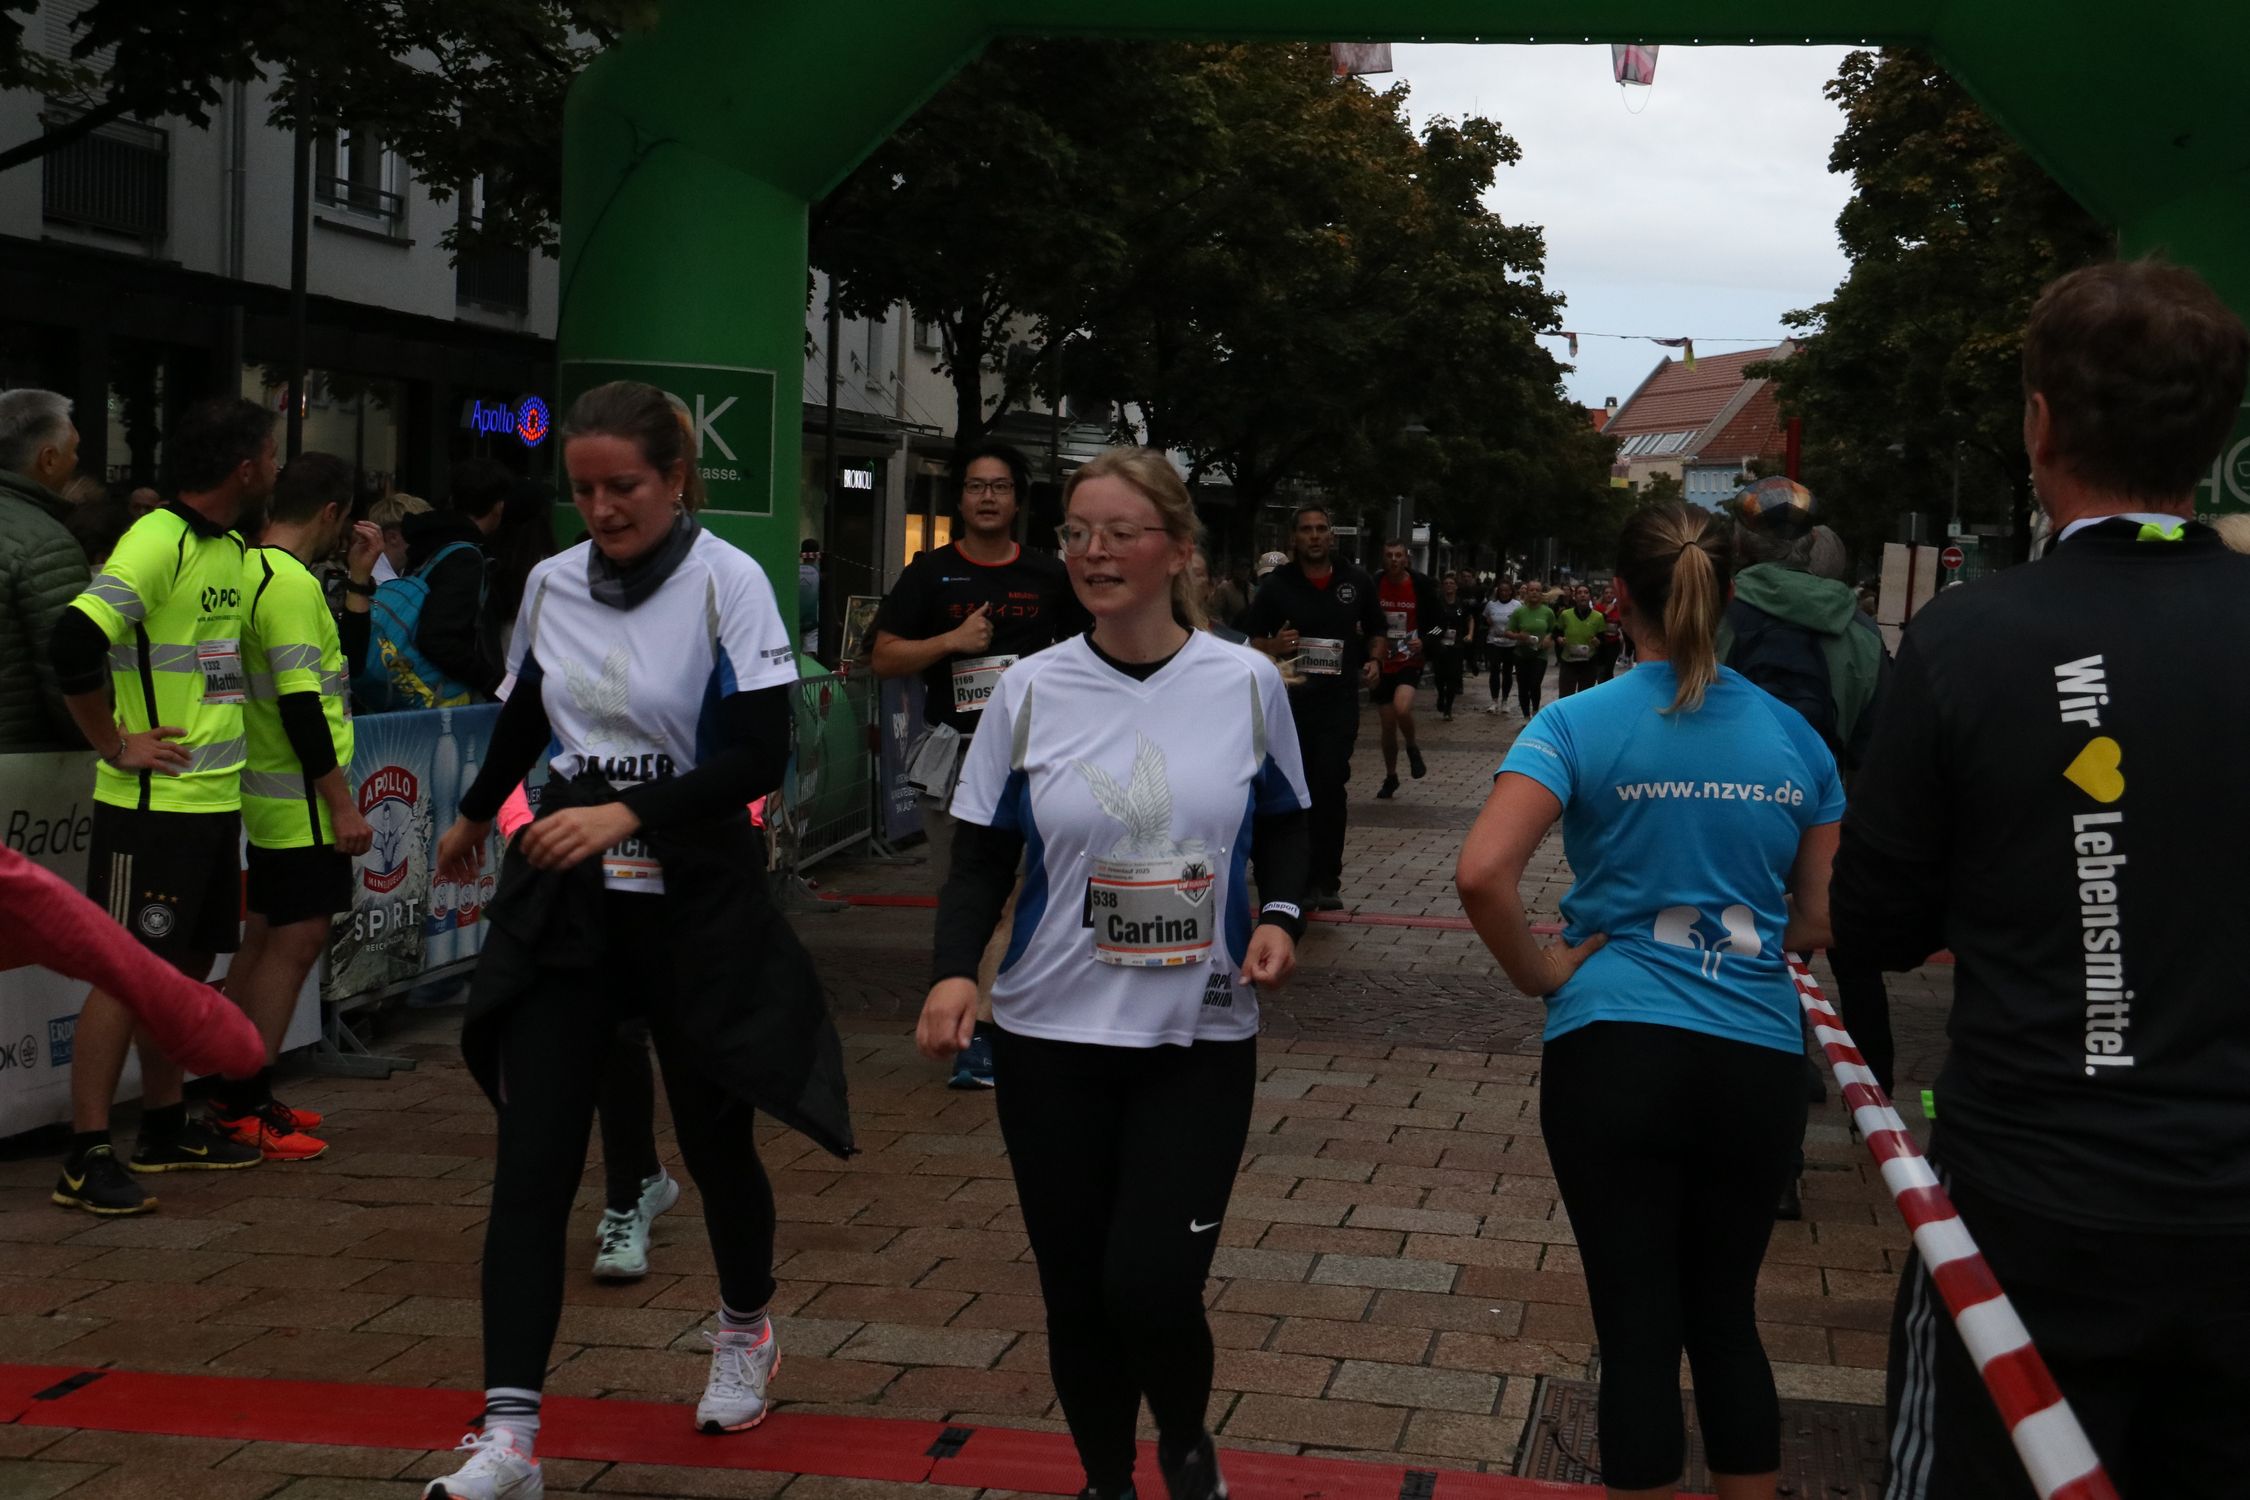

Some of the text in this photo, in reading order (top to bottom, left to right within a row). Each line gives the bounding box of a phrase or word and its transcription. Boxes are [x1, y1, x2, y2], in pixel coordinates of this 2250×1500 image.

[471, 400, 515, 438] Apollo
[695, 464, 741, 482] asse.
[203, 660, 221, 671] 1332
[1302, 655, 1339, 668] Thomas
[955, 675, 974, 686] 1169
[364, 773, 411, 806] APOLLO
[1615, 780, 1804, 806] www.nzvs.de
[1135, 866, 1150, 874] 2025
[2054, 654, 2136, 1077] Wir Lebensmittel.
[1092, 889, 1118, 908] 538
[1108, 914, 1198, 944] Carina
